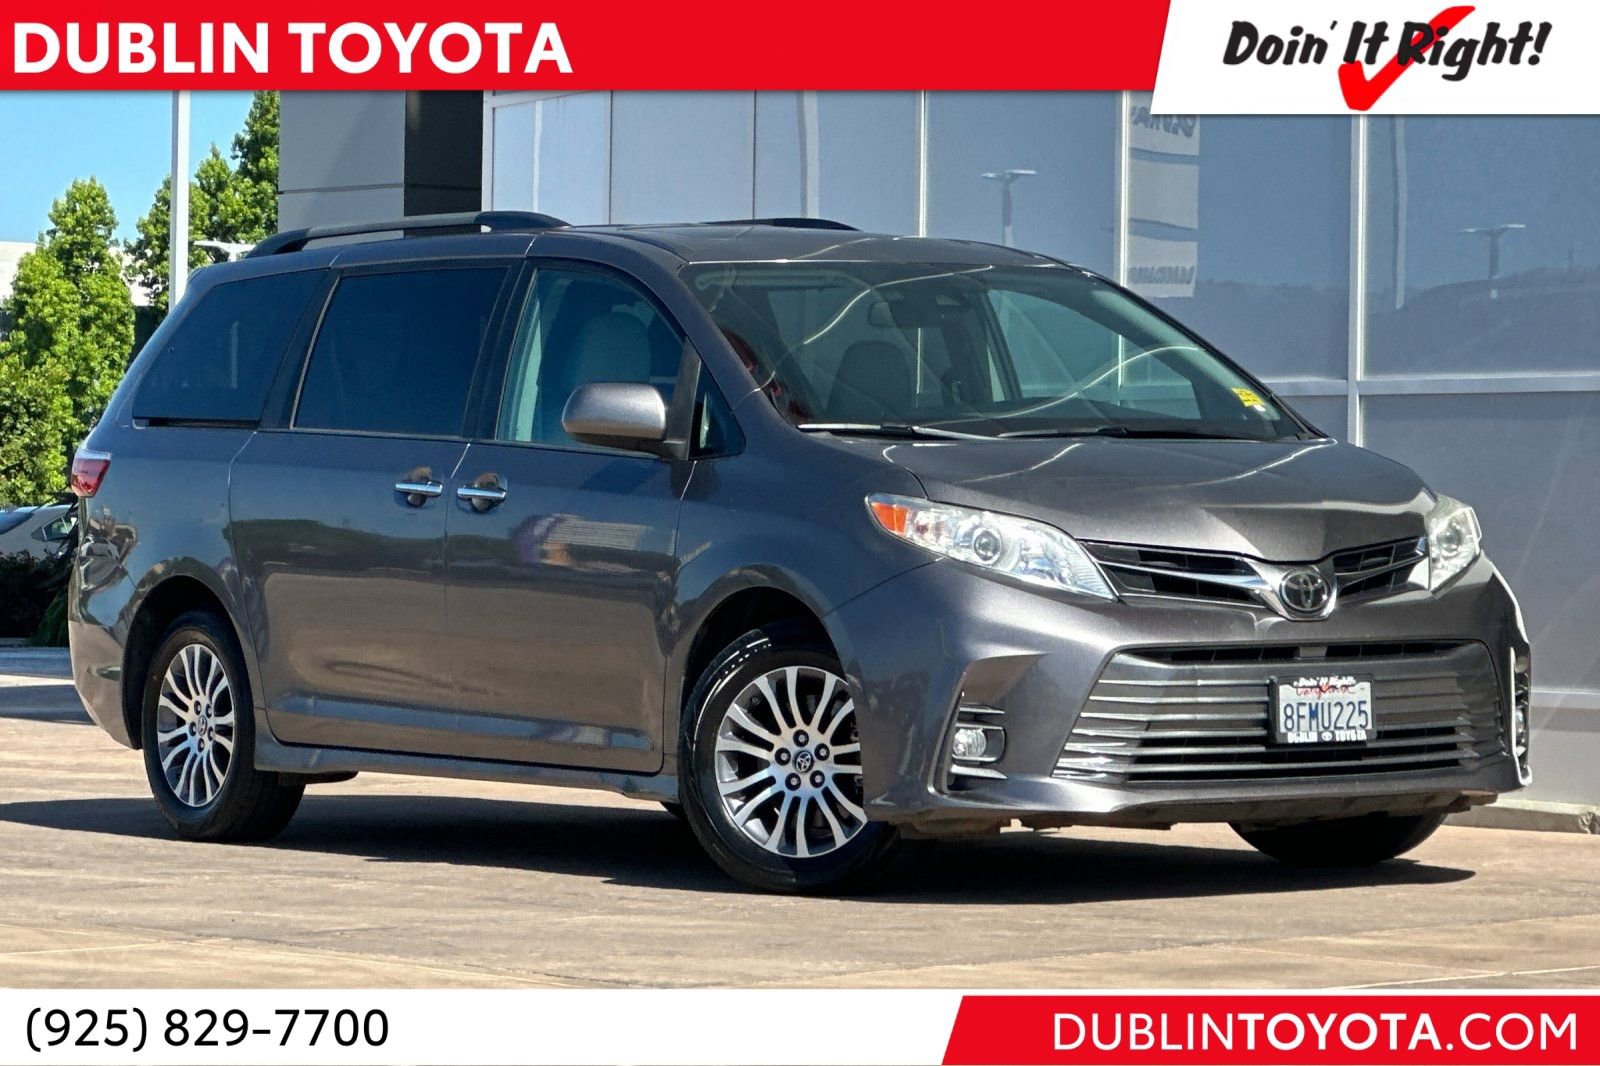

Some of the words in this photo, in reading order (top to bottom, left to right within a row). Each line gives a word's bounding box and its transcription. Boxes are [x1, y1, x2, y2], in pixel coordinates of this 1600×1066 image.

[1283, 700, 1369, 732] 8FMU225
[1287, 732, 1318, 744] DUBLIN
[1336, 730, 1368, 742] TOYOTA
